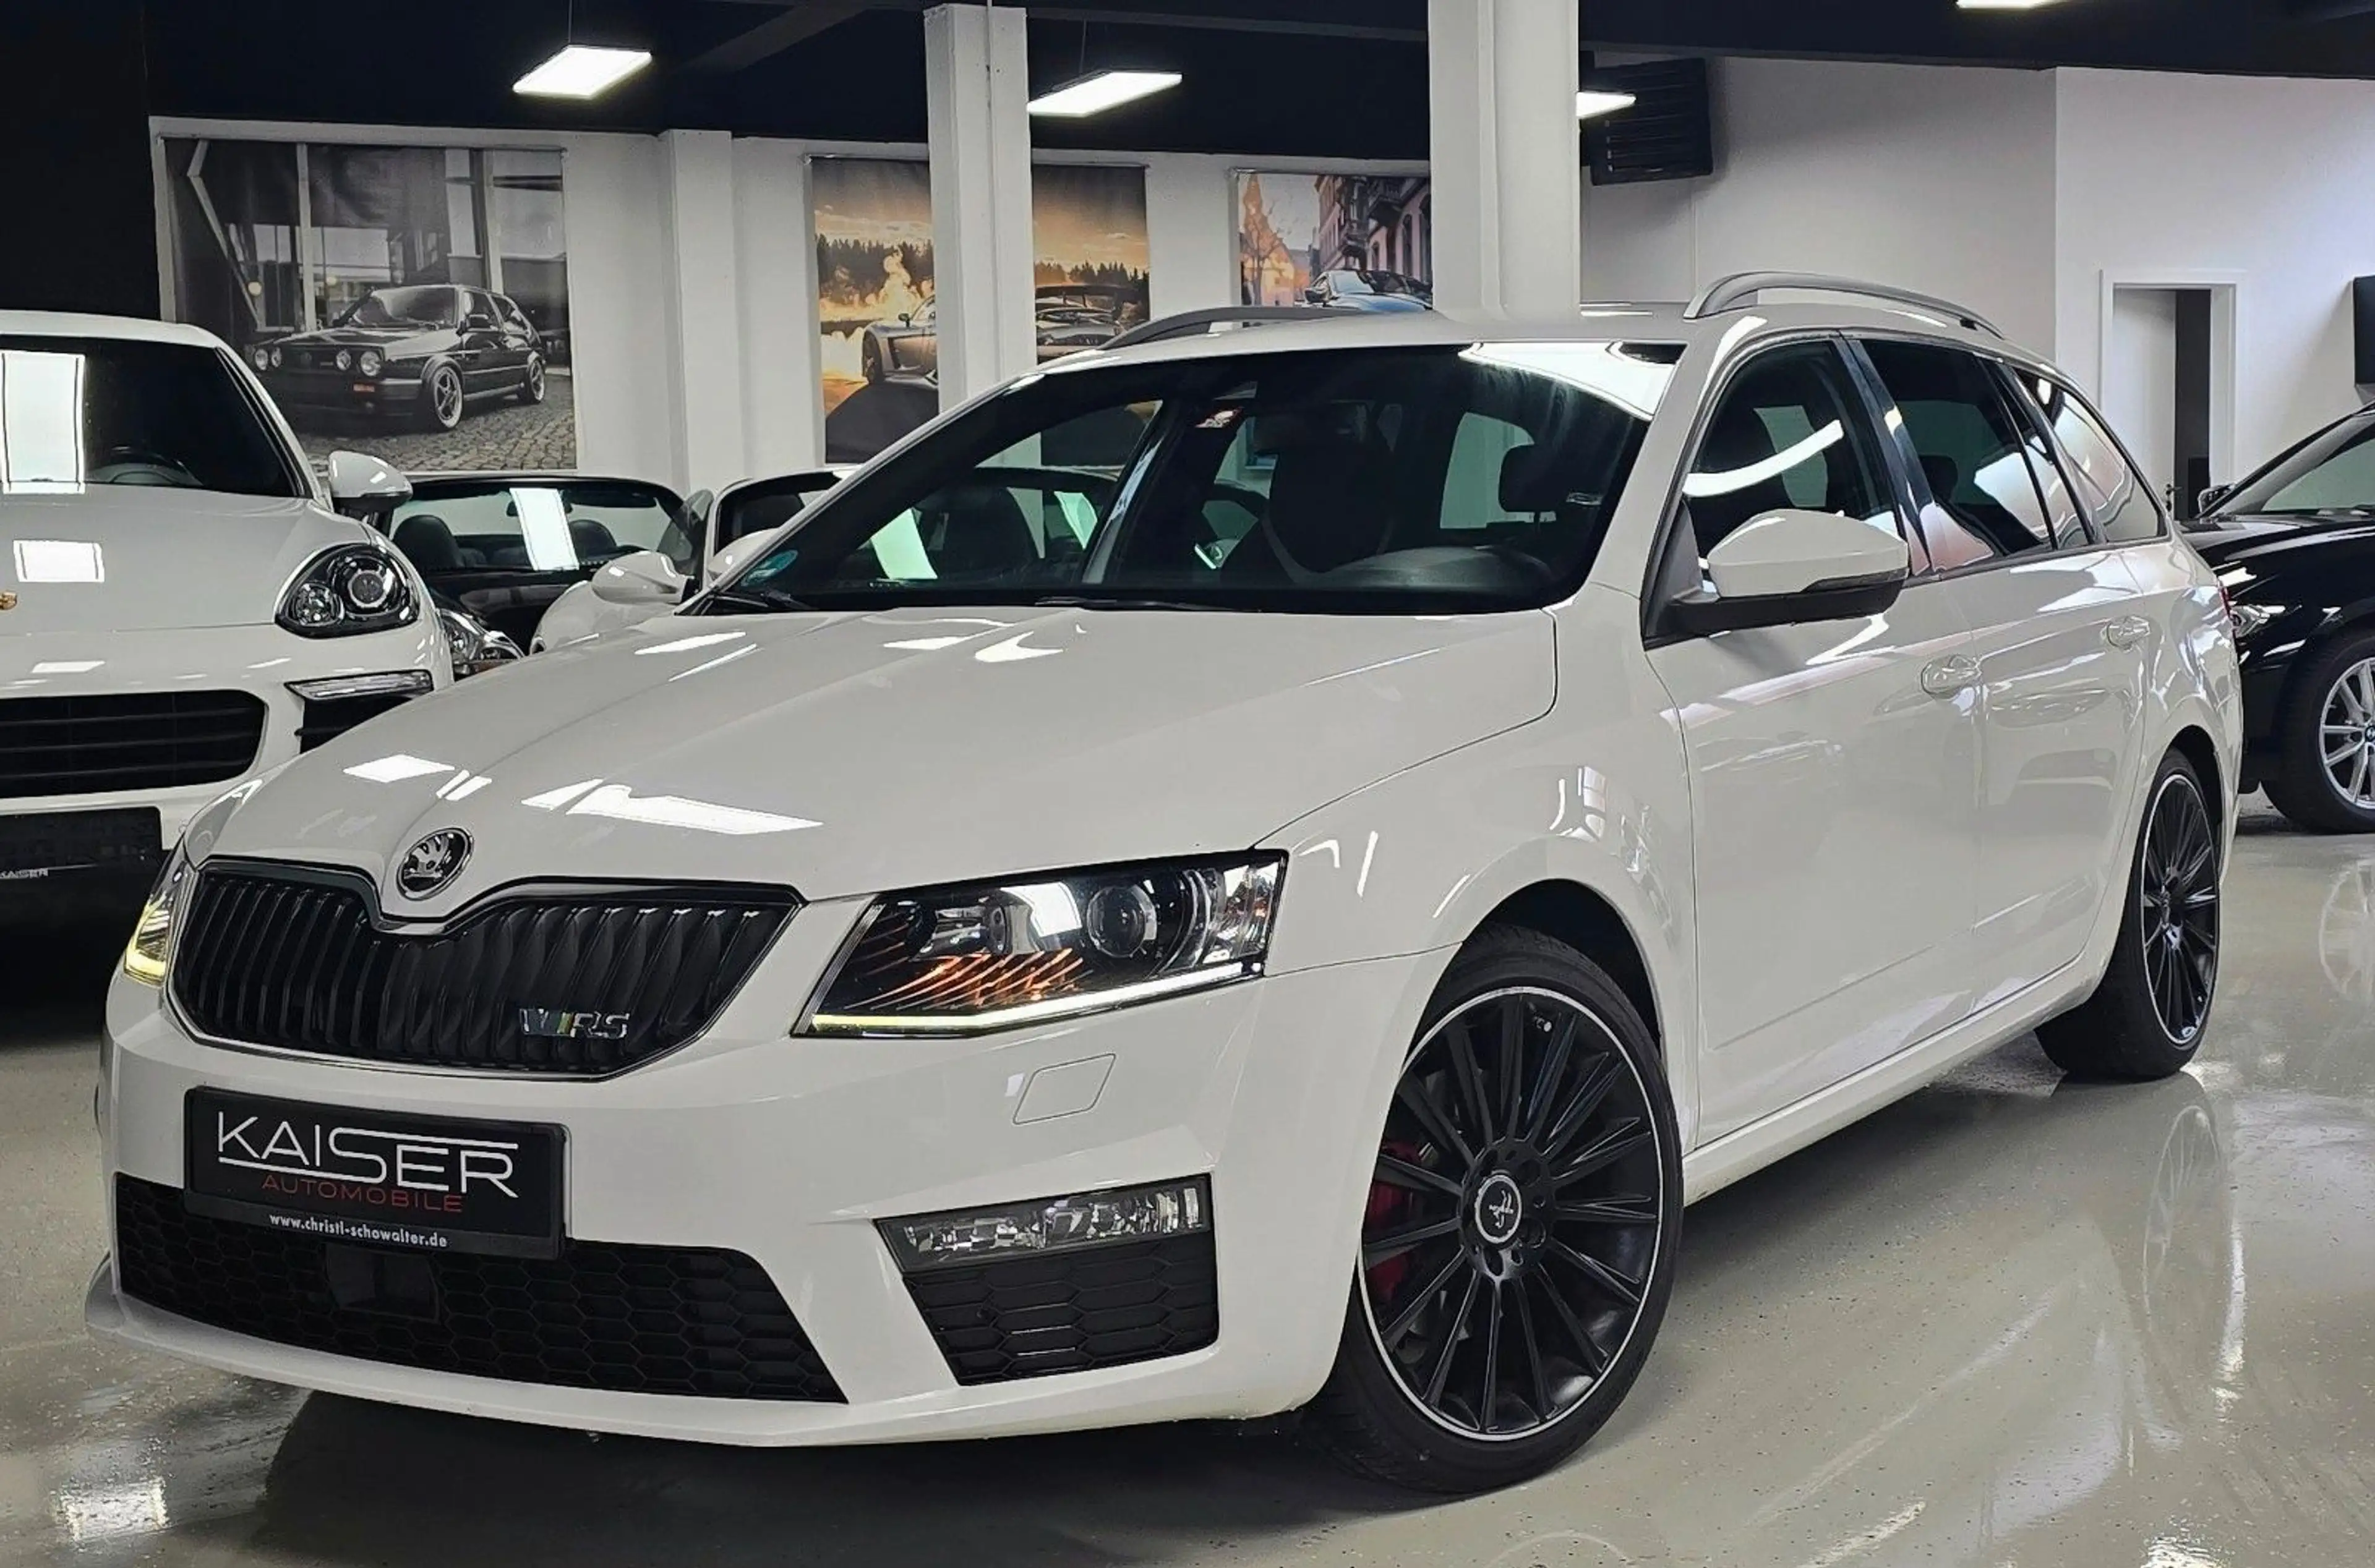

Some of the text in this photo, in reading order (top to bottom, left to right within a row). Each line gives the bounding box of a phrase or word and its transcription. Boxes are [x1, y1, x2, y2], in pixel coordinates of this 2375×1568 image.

[218, 1111, 519, 1198] KAISER
[261, 1174, 464, 1213] AUTOMOBILE
[269, 1212, 448, 1248] www.christl-schowalter.de
